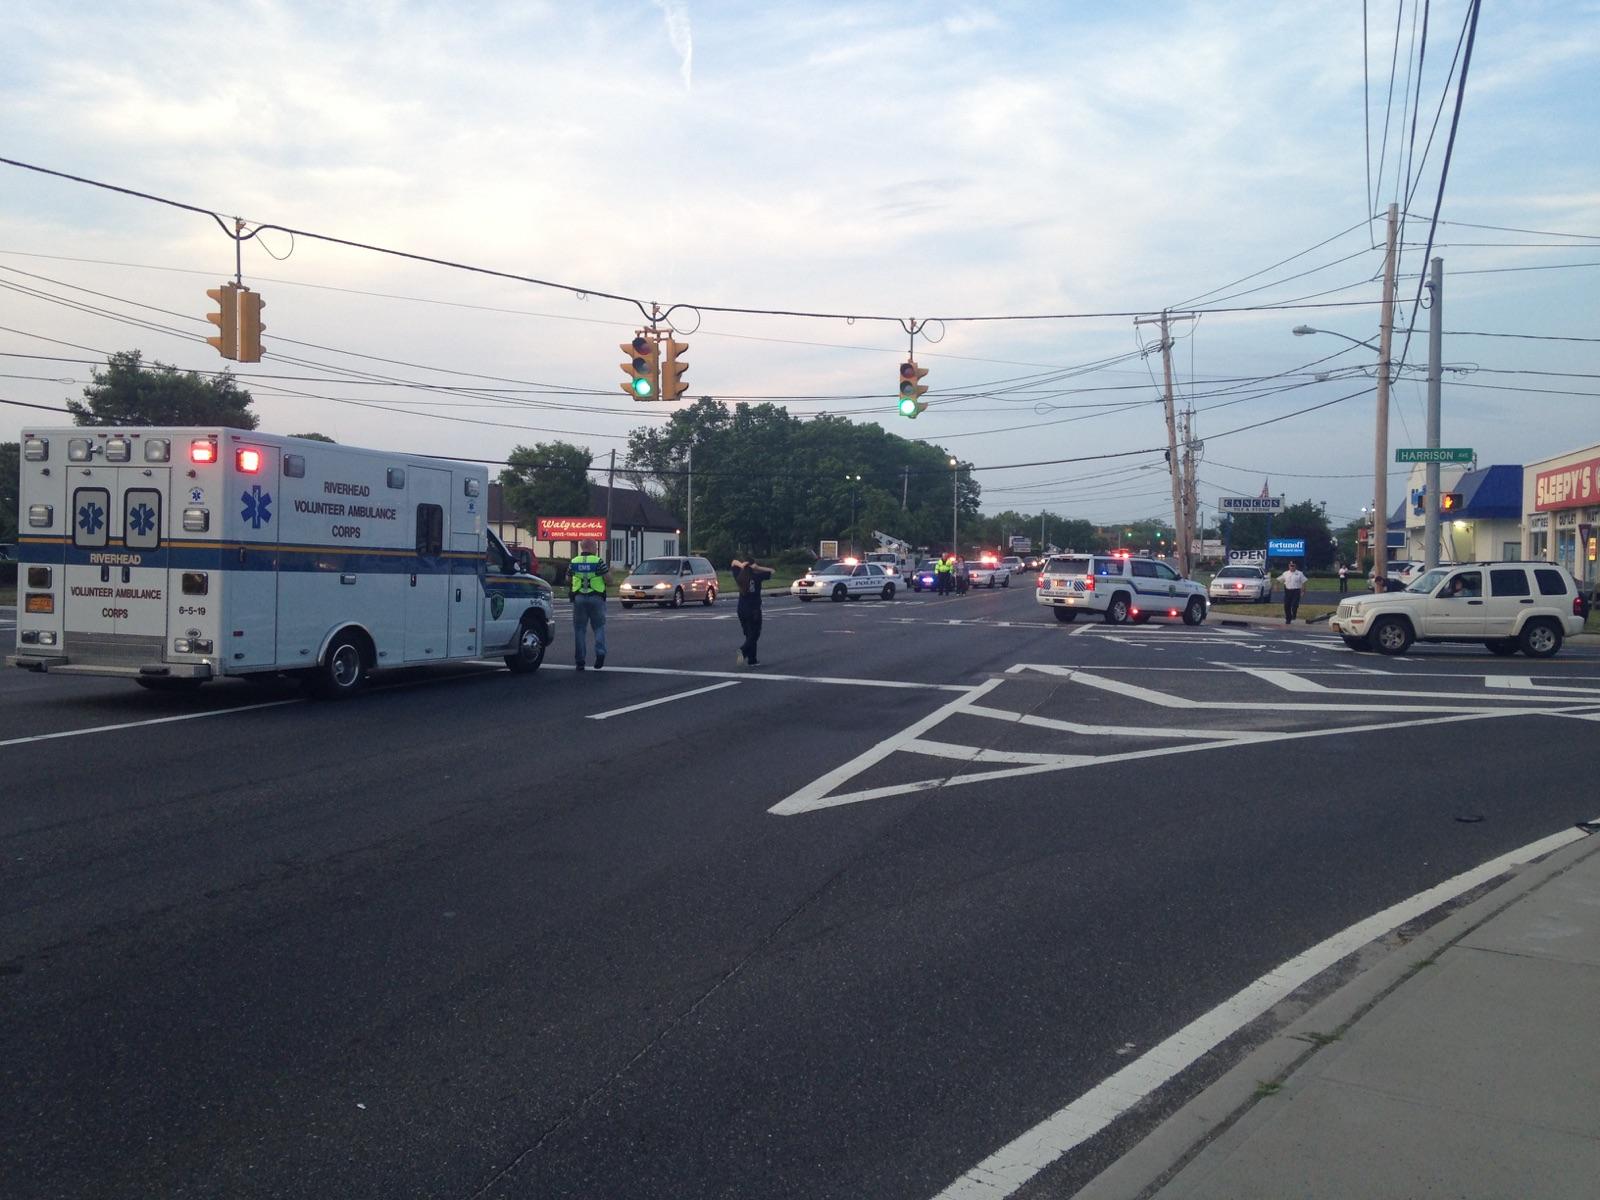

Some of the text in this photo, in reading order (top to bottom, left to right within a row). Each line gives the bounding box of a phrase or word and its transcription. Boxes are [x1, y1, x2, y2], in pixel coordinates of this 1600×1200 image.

[1401, 451, 1454, 460] HARRISON
[324, 481, 370, 497] RIVERHEAD
[1537, 466, 1591, 506] SLEEPY'S
[1225, 499, 1280, 508] CANCOS
[294, 500, 396, 520] VOLUNTEER AMBULANCE
[541, 520, 603, 531] Walgreens
[331, 525, 361, 538] CORPS
[90, 553, 142, 565] RIVERHEAD
[1230, 550, 1265, 560] OPEN
[71, 586, 162, 600] VOLUNTEER AMBULANCE
[102, 608, 128, 619] CORPS
[179, 606, 206, 615] 6-5-19
